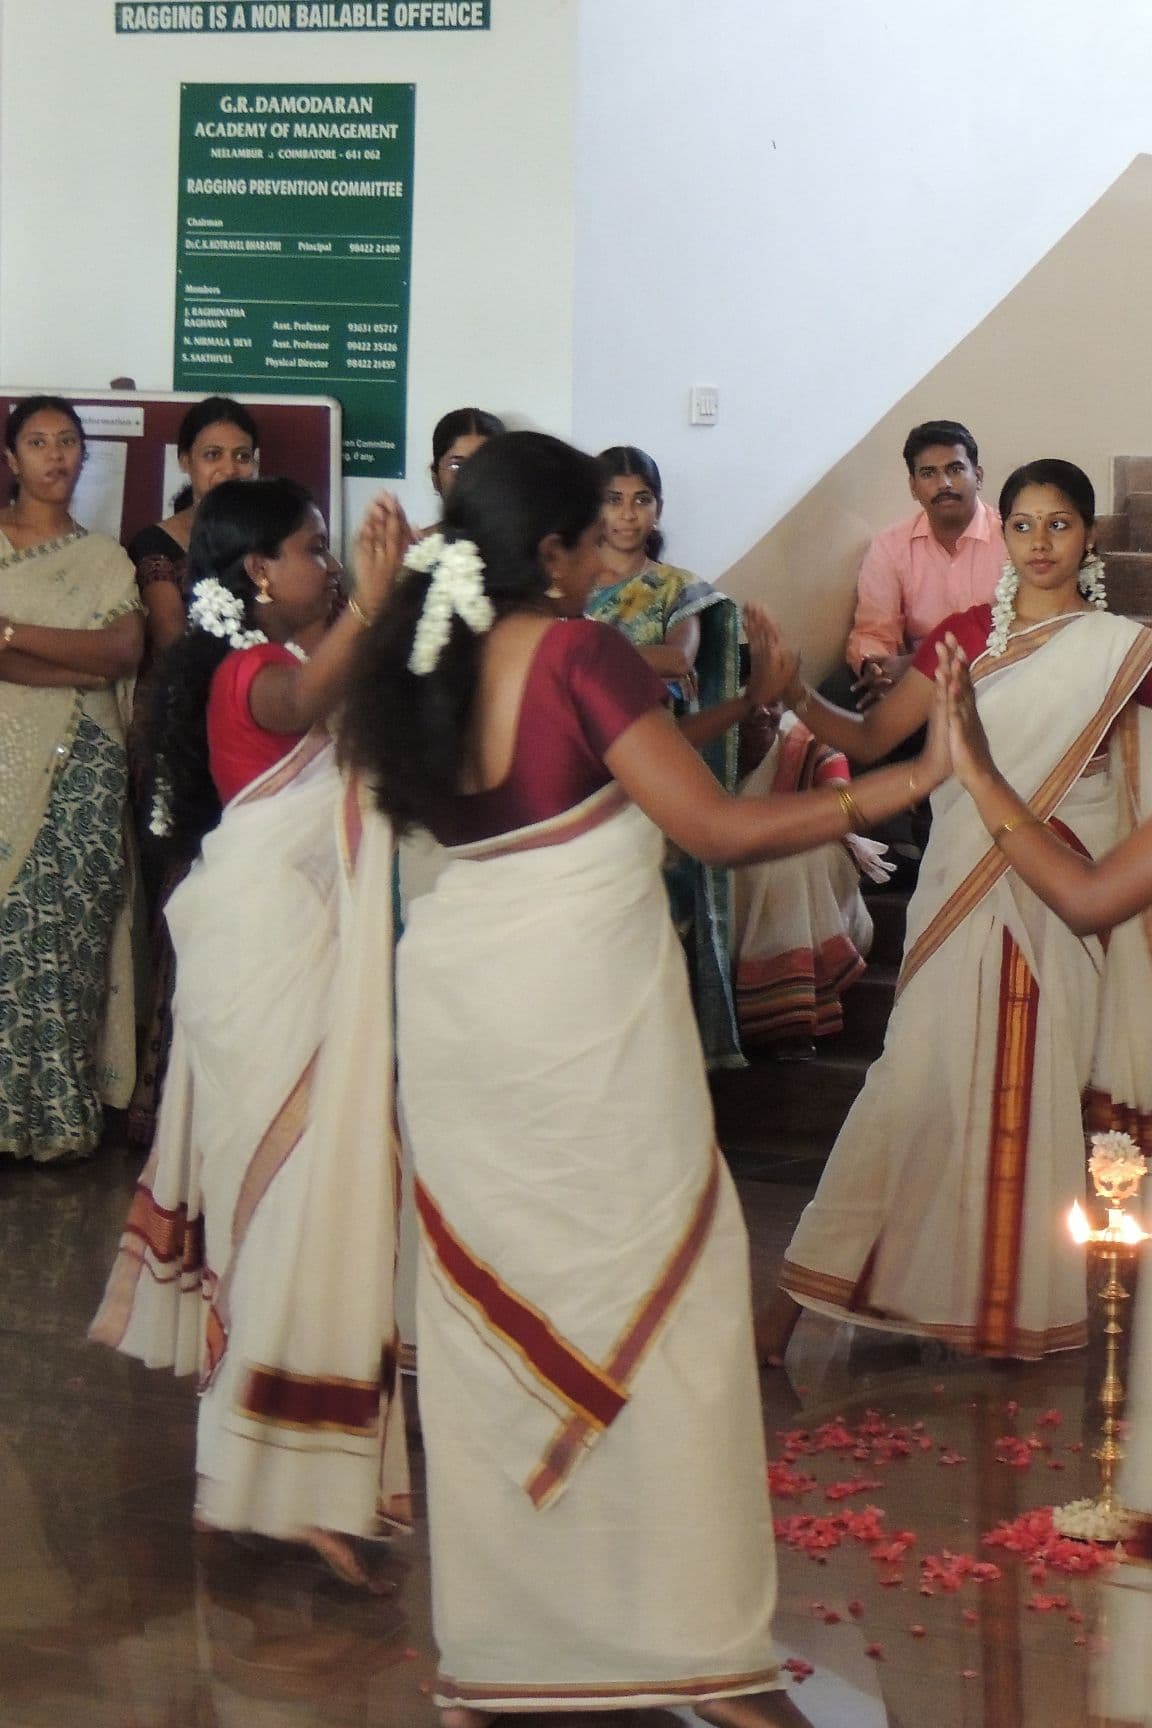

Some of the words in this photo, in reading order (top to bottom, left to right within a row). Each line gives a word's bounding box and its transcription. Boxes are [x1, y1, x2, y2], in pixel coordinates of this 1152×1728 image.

[121, 5, 203, 31] RAGGING
[210, 5, 228, 30] IS
[232, 5, 246, 29] A
[251, 4, 290, 29] NON
[296, 3, 389, 29] BAILABLE
[394, 1, 485, 27] OFFENCE
[194, 122, 267, 138] ACADEMY
[270, 123, 290, 138] OF
[294, 123, 399, 139] MANAGEMENT
[186, 179, 247, 195] RAGGING
[250, 180, 329, 196] PREVENTION
[331, 181, 403, 198] COMMITTEE
[187, 217, 224, 227] Chairman
[298, 241, 332, 252] Principal
[184, 284, 221, 295] Members
[294, 321, 331, 332] Professor
[293, 340, 330, 350] Professor
[264, 356, 296, 368] Physical
[297, 357, 330, 369] Director
